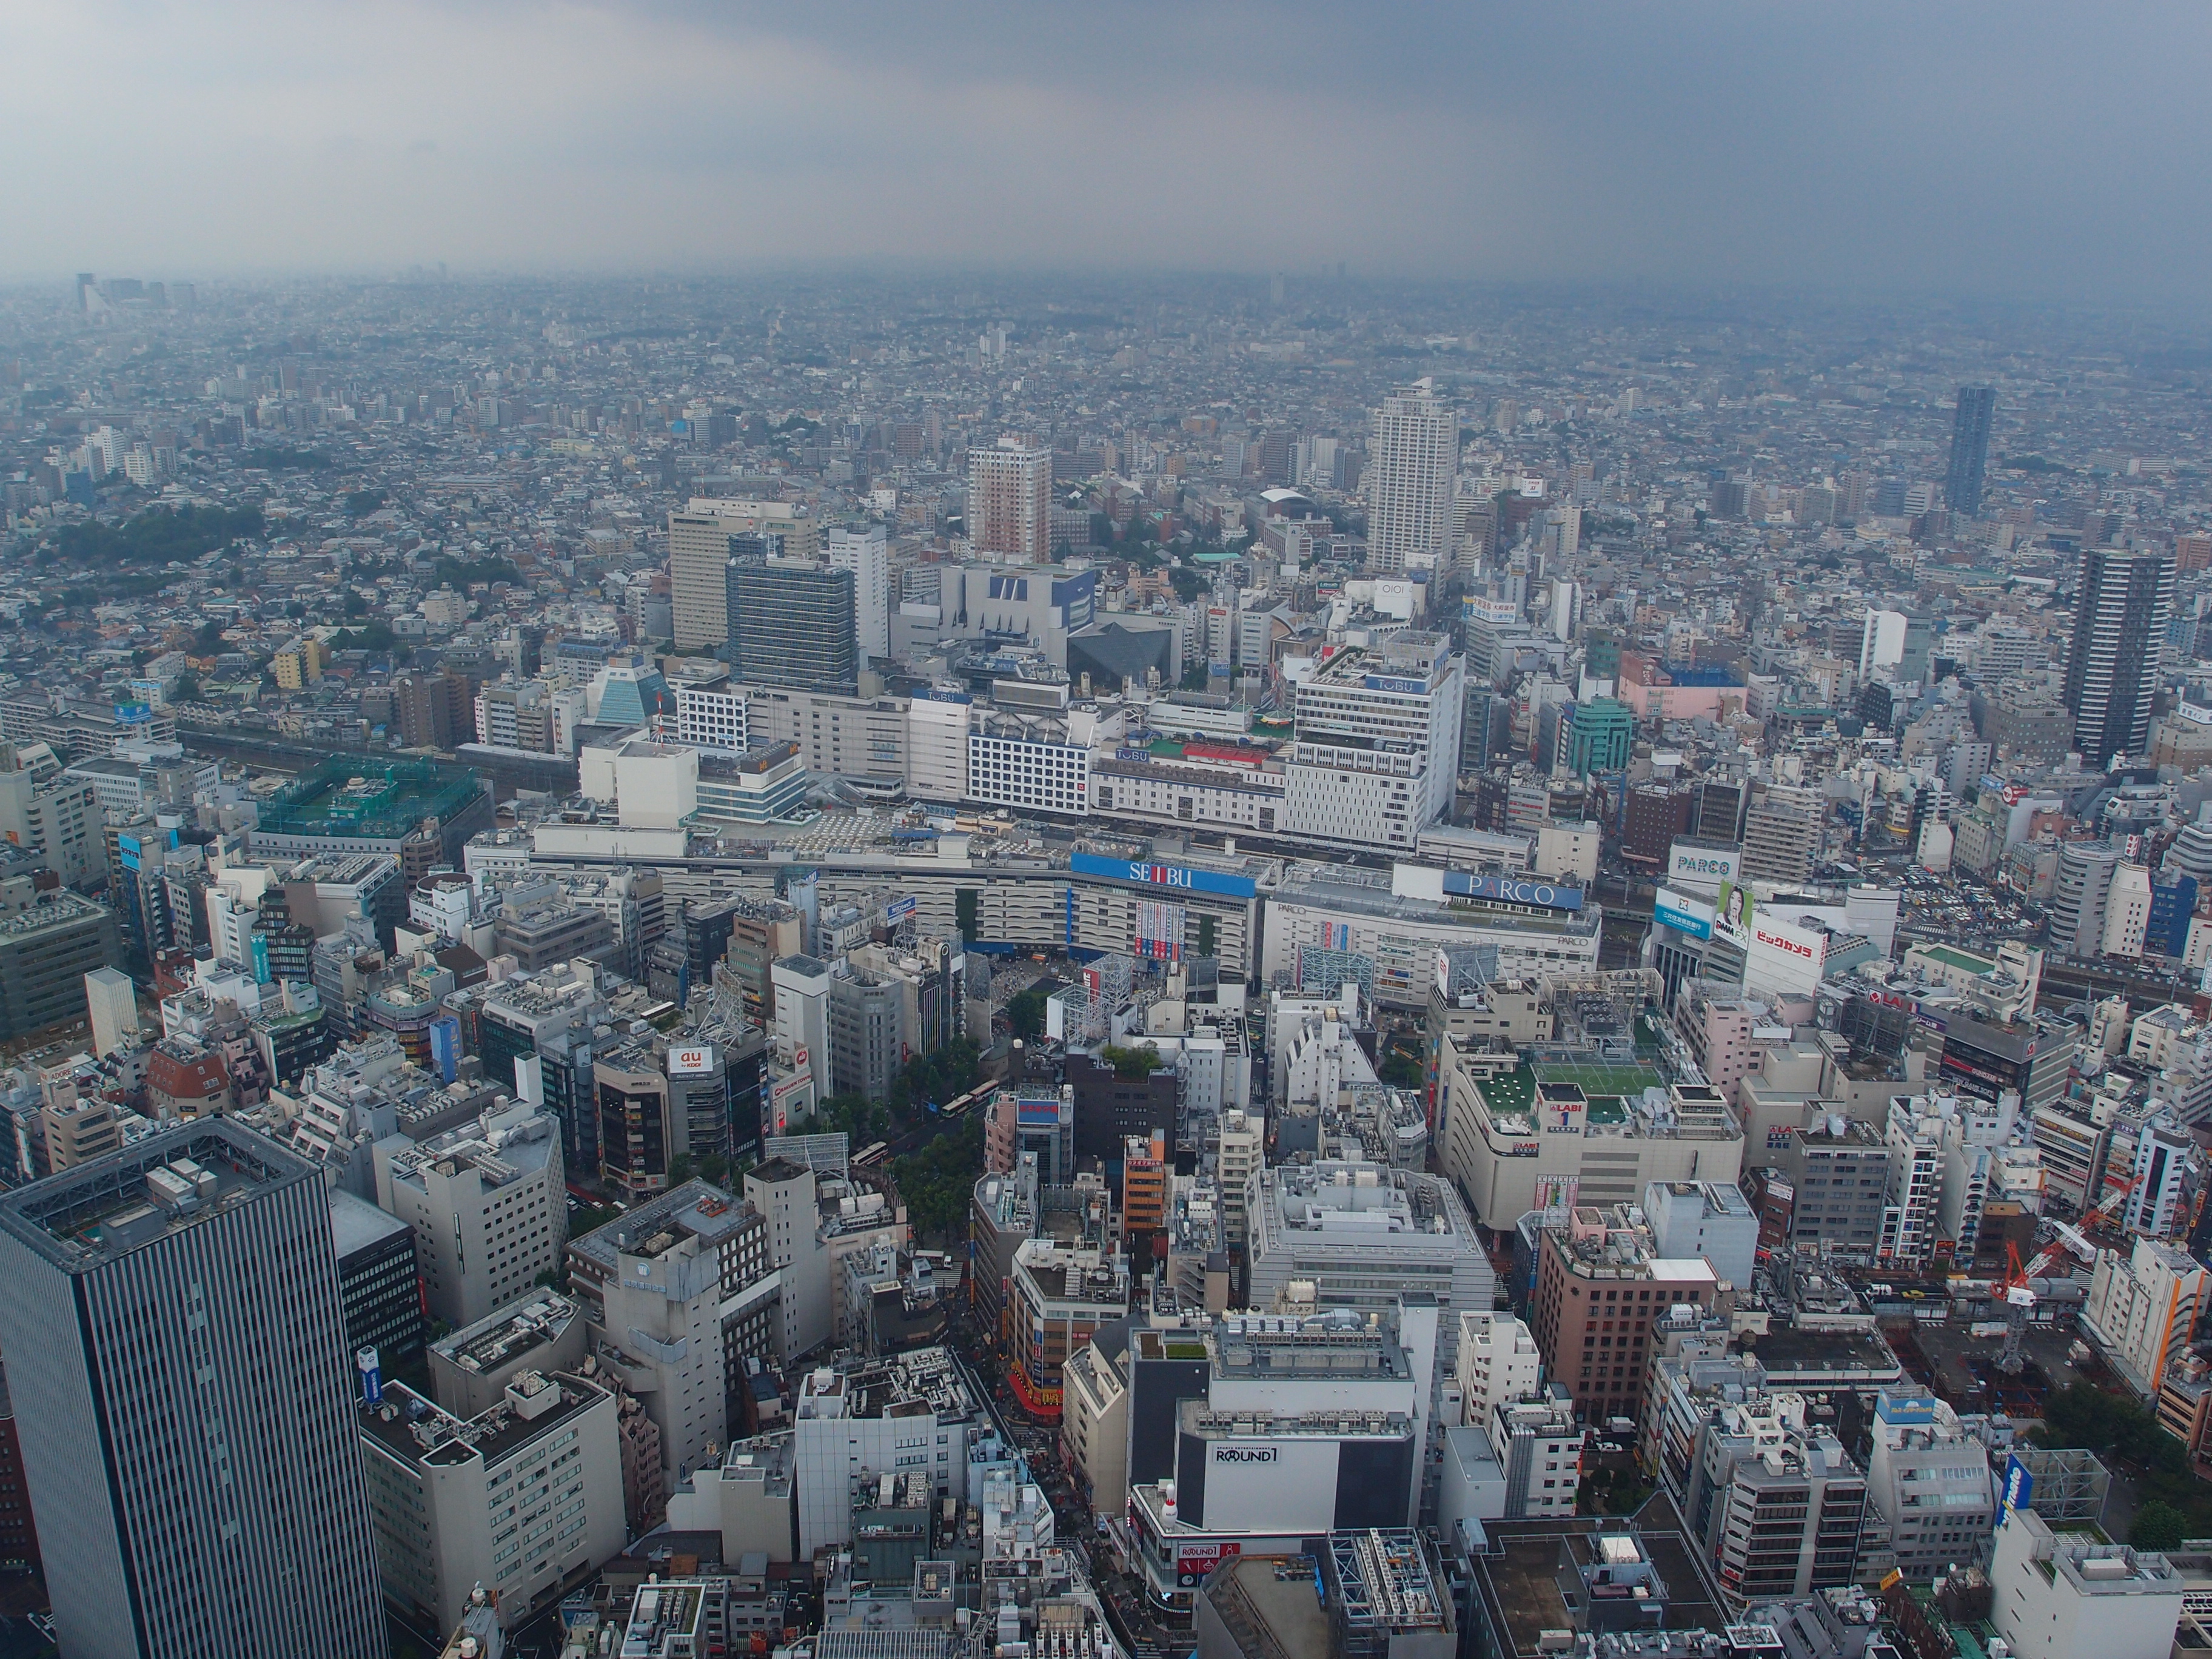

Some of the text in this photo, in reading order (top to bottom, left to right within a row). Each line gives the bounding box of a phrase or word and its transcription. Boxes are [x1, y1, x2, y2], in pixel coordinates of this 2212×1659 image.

[1378, 679, 1412, 691] TOBU
[928, 691, 954, 703] TOBU
[1116, 749, 1147, 762] TOBU
[1677, 856, 1730, 875] PARCO
[1130, 862, 1192, 888] SEIBU
[1469, 876, 1555, 905] PARCO
[1278, 903, 1306, 915] PARCO
[1716, 920, 1748, 943] DMM FX
[1558, 936, 1589, 947] PARCO
[1757, 930, 1812, 958] ビックカメラ
[681, 1052, 702, 1062] au
[51, 1068, 72, 1080] ADORE
[1216, 1447, 1277, 1462] ROUND1
[1182, 1546, 1217, 1556] ROUND1
